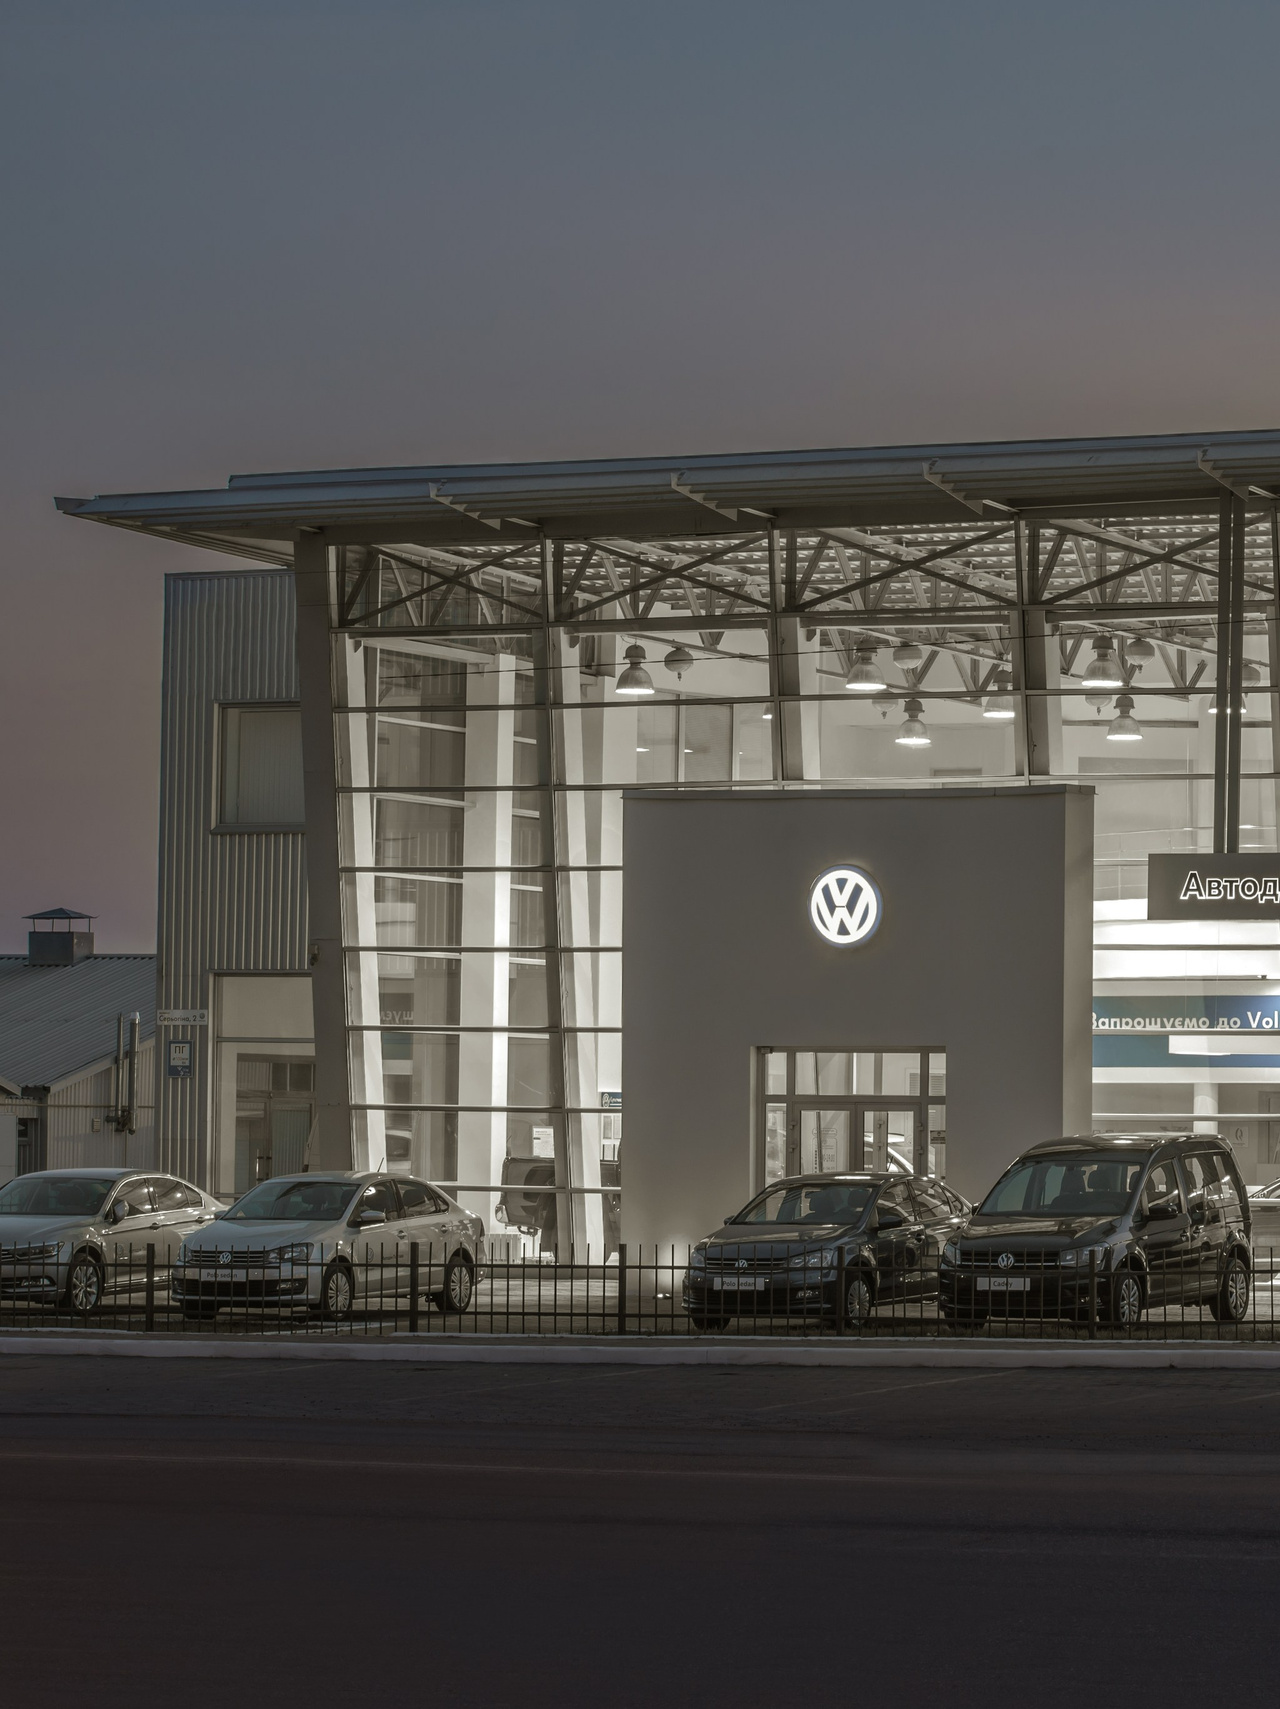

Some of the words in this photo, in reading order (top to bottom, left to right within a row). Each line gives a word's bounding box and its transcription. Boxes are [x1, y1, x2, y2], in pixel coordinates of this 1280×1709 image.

[192, 1014, 197, 1022] 2
[1217, 1017, 1241, 1029] до
[174, 1045, 186, 1054] ПГ
[993, 1280, 1013, 1288] Cady
